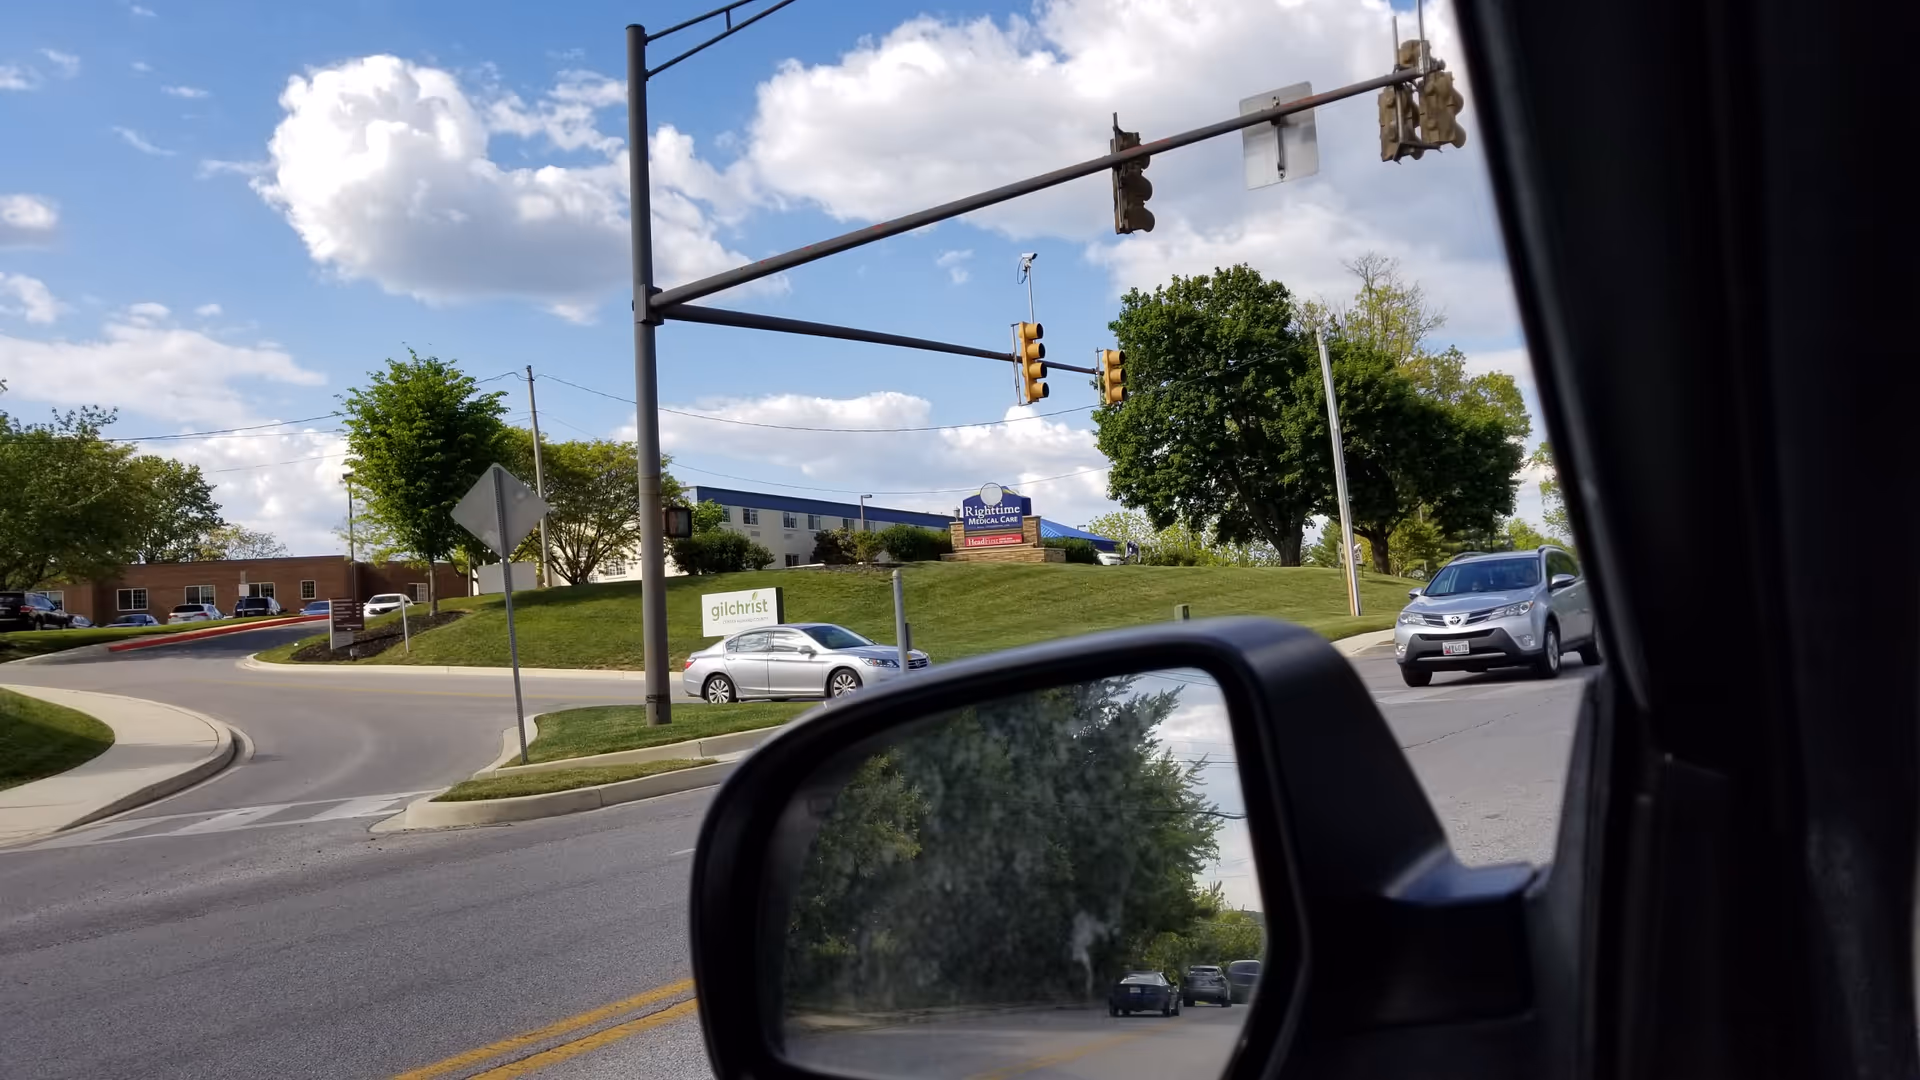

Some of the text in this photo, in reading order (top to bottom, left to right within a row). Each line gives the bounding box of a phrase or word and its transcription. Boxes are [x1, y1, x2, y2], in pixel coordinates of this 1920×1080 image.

[965, 503, 1021, 518] Righttime
[968, 515, 1018, 526] MEDICAL CARE
[711, 599, 768, 622] gilchrist
